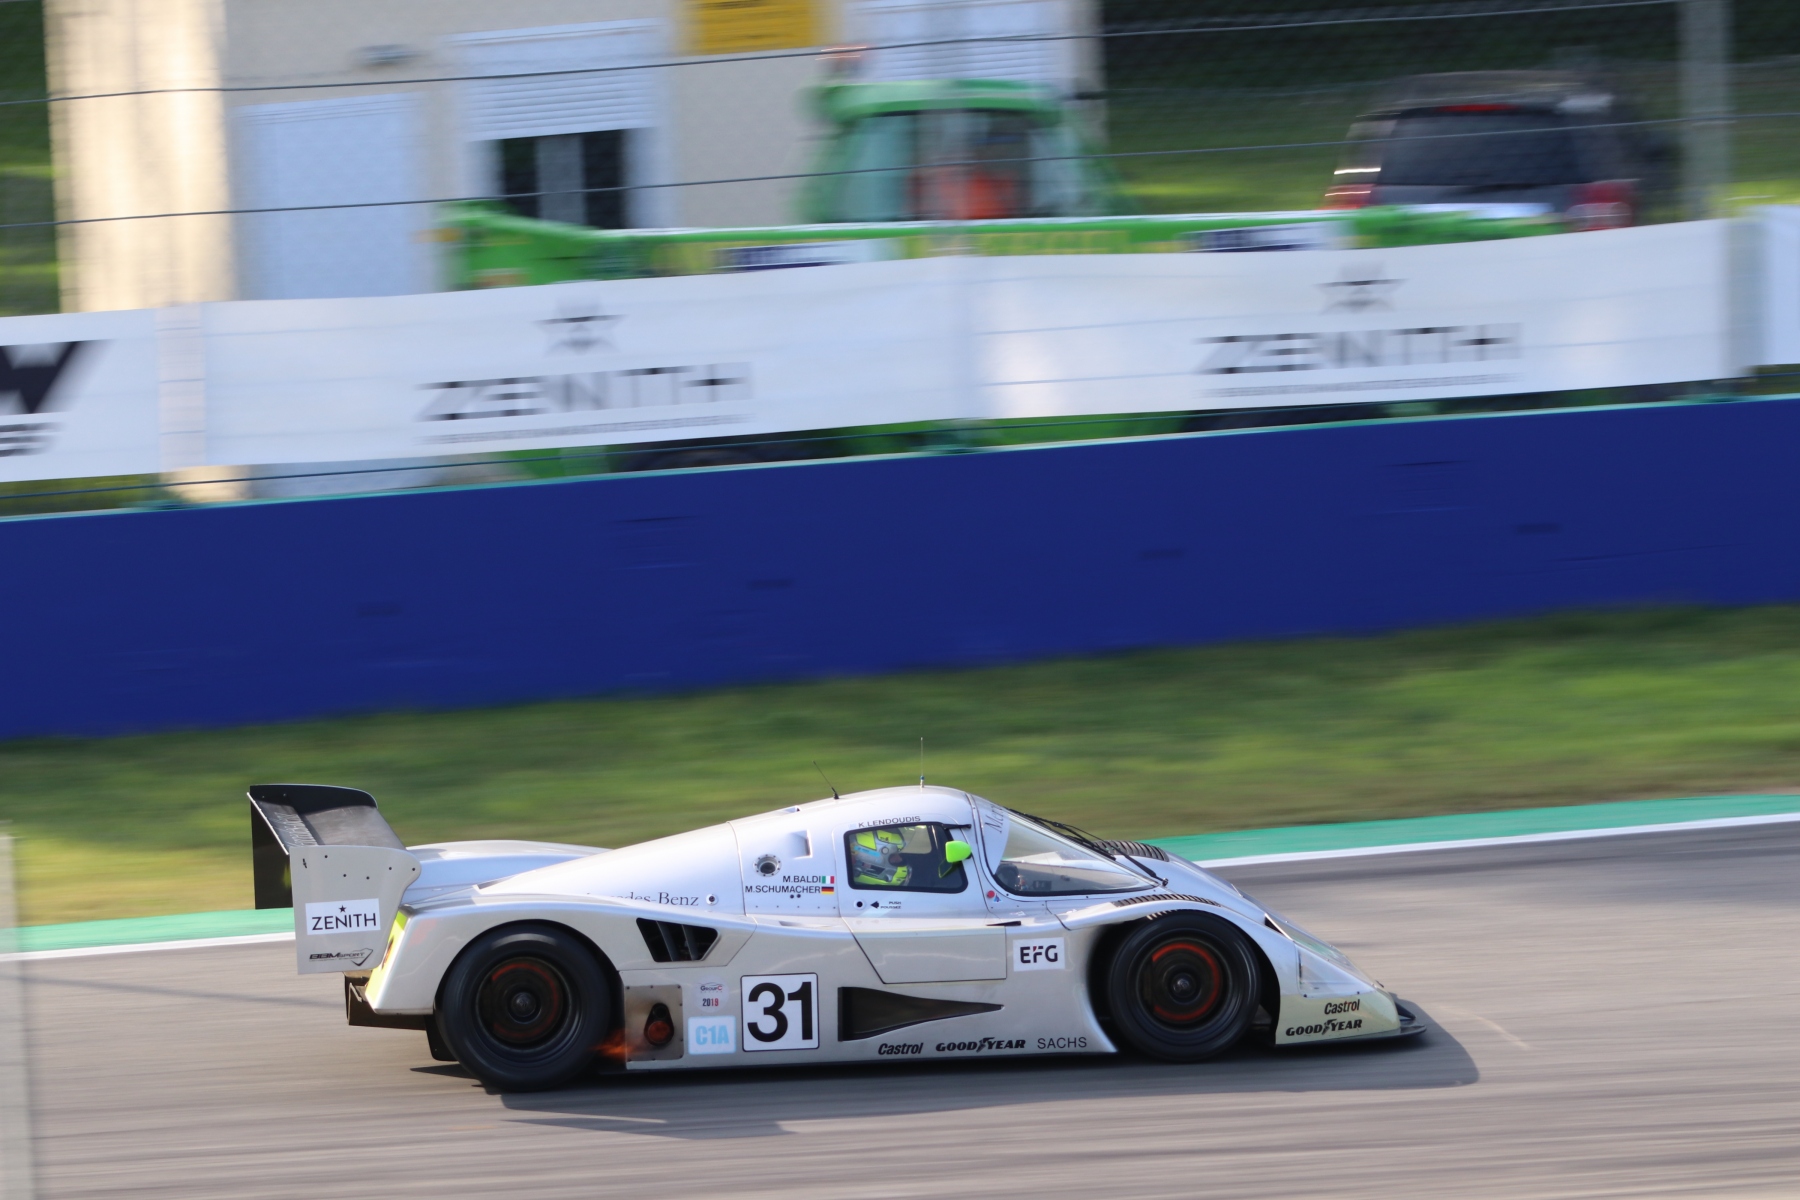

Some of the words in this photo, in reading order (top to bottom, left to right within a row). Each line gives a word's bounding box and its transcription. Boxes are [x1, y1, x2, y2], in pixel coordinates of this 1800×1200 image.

[782, 875, 821, 883] M.BALDI
[745, 885, 821, 893] M.SCHUMACHER
[311, 912, 377, 931] ZENITH
[1020, 944, 1058, 964] EFG
[702, 998, 719, 1007] 2019
[747, 981, 813, 1043] 31
[1324, 998, 1361, 1015] Castrol
[695, 1024, 730, 1046] C1A
[878, 1042, 924, 1056] Castrol
[1037, 1036, 1088, 1049] SACHS
